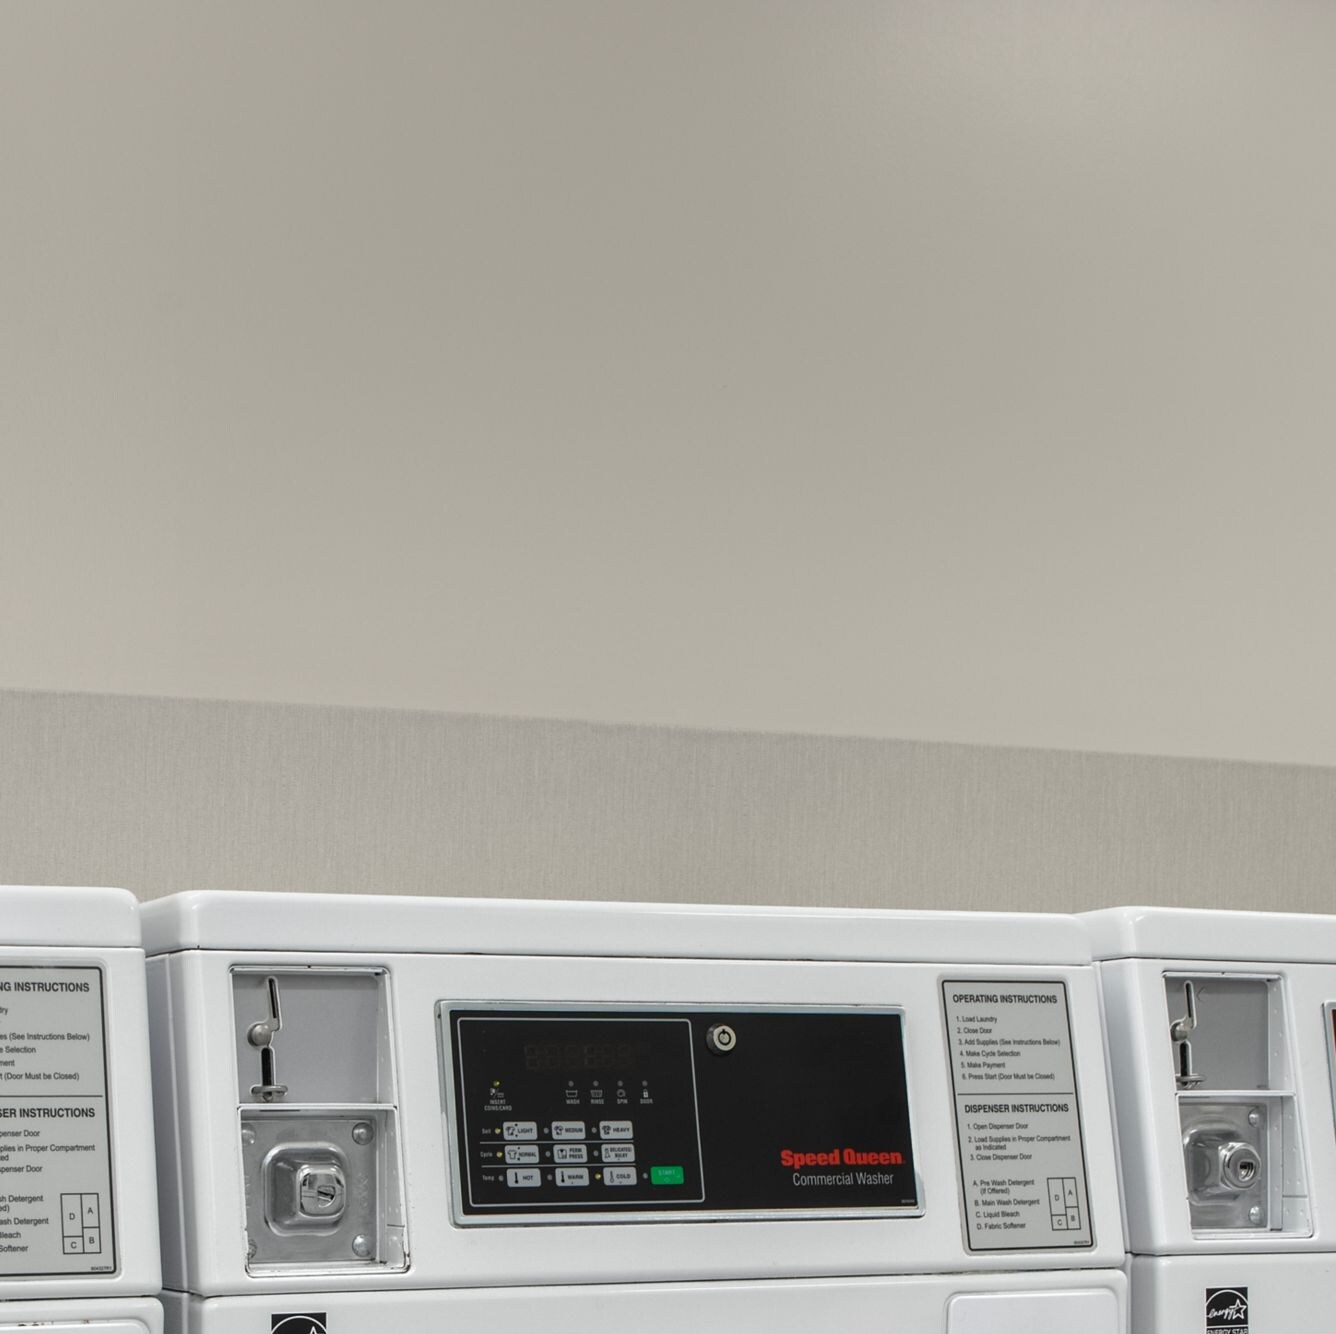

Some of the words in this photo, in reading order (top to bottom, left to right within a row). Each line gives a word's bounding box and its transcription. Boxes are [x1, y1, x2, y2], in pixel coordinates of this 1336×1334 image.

[14, 982, 89, 992] INSTRUCTIONS
[953, 994, 998, 1003] OPERATING
[1000, 995, 1057, 1003] INSTRUCTIONS
[9, 1033, 25, 1041] (See
[4, 1072, 23, 1081] (Door
[54, 1072, 79, 1081] Closed)
[20, 1108, 95, 1117] INSTRUCTIONS
[965, 1105, 1009, 1113] DISPENSER
[1012, 1104, 1069, 1112] INSTRUCTIONS
[781, 1149, 840, 1169] Speed
[843, 1148, 902, 1164] Queen
[793, 1173, 853, 1185] Commercial
[856, 1173, 893, 1184] Washer
[9, 1195, 43, 1204] Detergent
